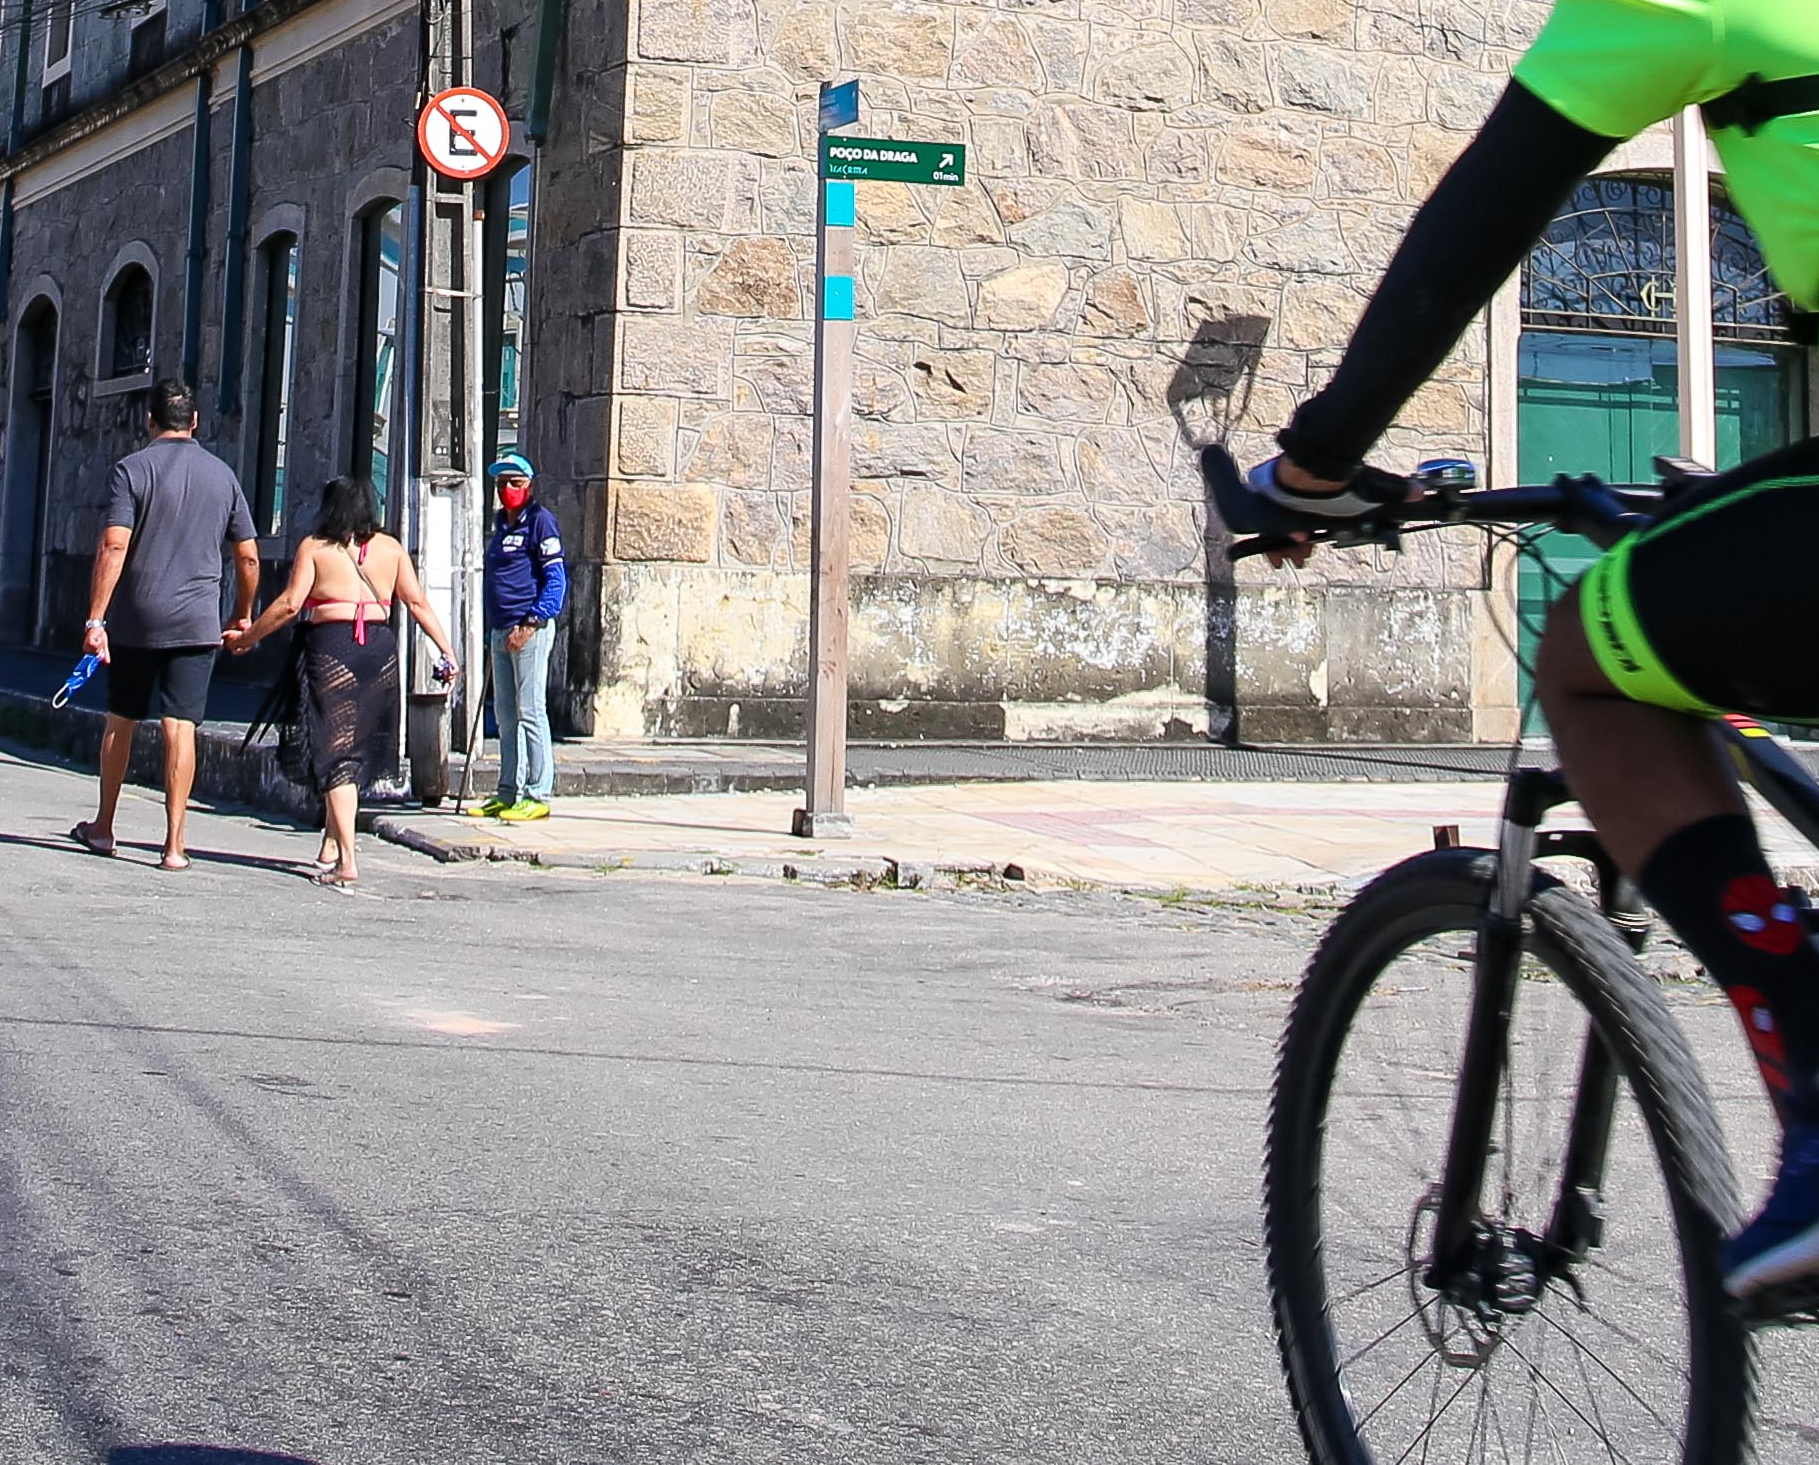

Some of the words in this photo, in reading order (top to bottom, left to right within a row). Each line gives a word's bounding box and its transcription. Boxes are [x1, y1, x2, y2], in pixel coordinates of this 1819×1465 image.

[449, 109, 477, 156] E
[829, 146, 862, 162] POÇO
[862, 149, 879, 161] DA
[879, 150, 918, 163] DRAGA
